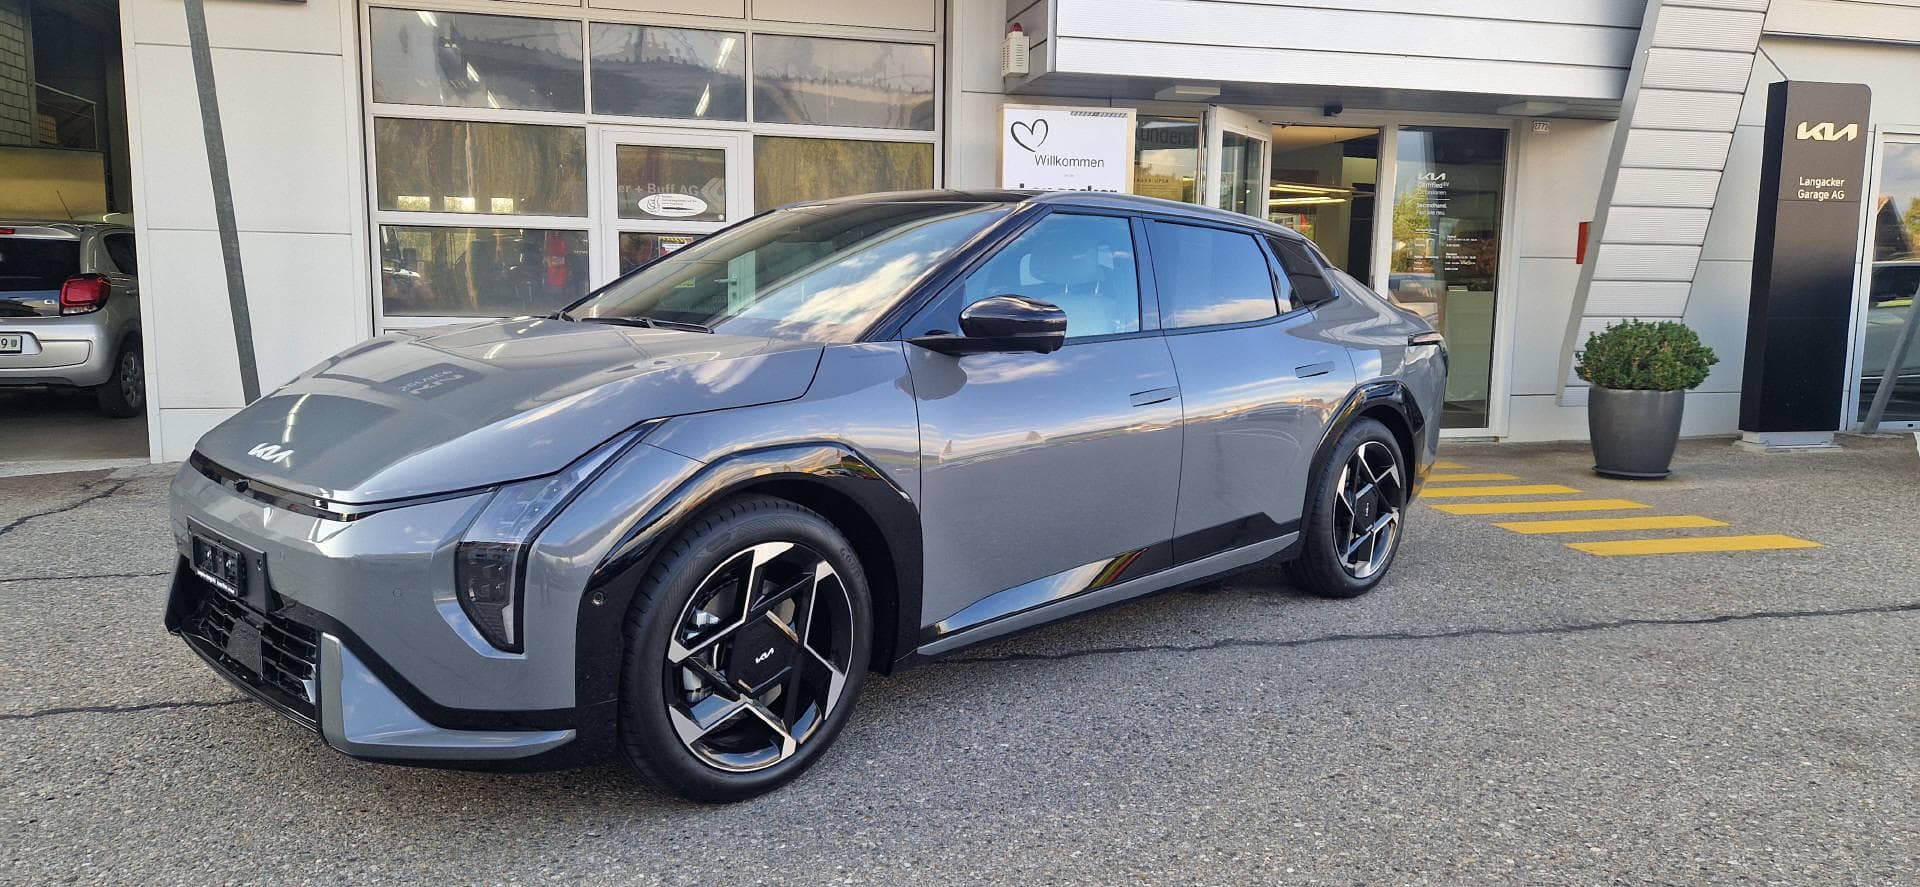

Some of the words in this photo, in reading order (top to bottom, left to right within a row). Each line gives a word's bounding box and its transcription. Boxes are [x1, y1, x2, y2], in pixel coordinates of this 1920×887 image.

[1797, 122, 1858, 142] KIA
[1034, 154, 1105, 168] Willkommen
[1799, 176, 1845, 189] Langacker
[1798, 189, 1830, 202] Garage
[1831, 190, 1845, 200] AG
